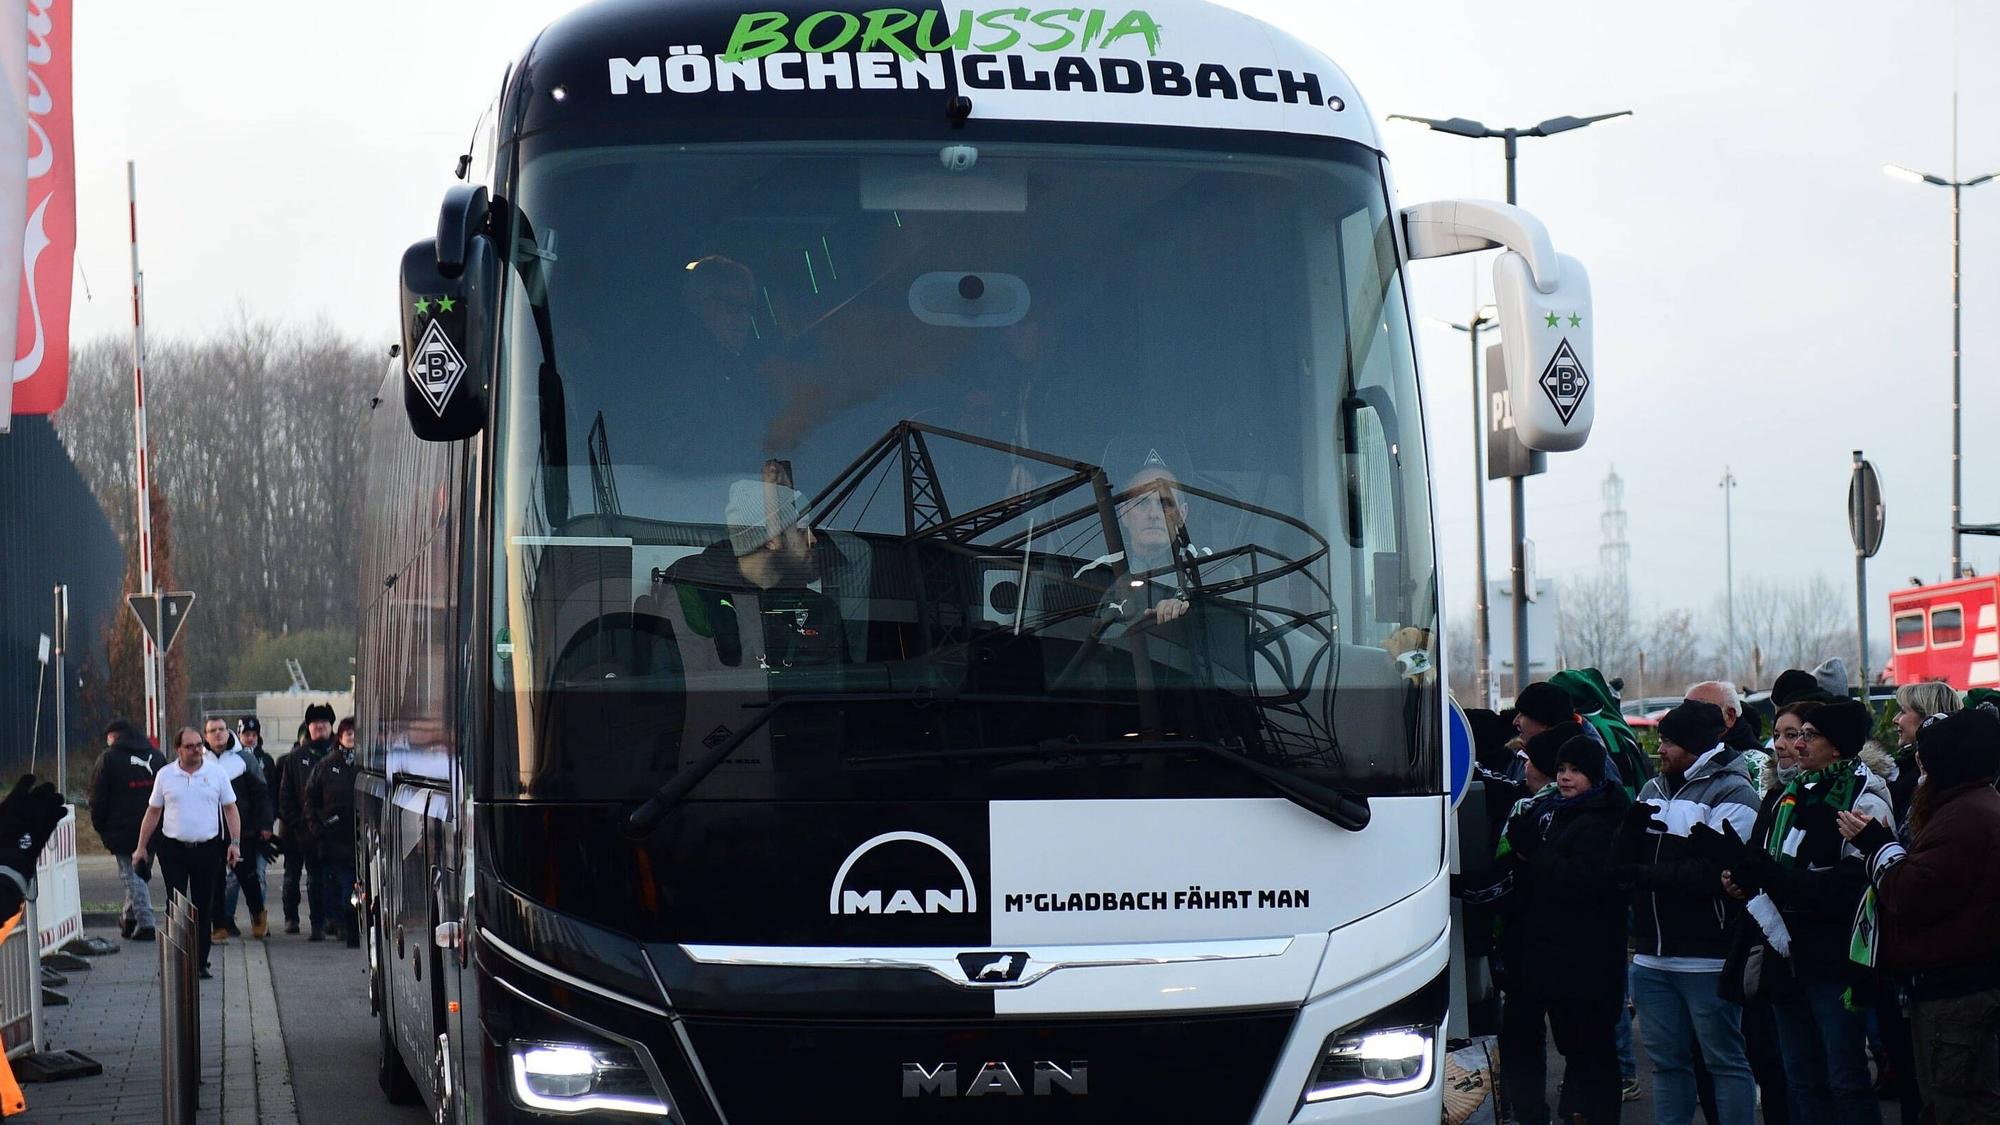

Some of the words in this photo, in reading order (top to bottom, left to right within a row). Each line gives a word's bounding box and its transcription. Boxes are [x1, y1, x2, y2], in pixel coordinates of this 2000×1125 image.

[719, 10, 1163, 63] BORUSSIA
[843, 889, 964, 914] MAN
[1004, 891, 1168, 913] M'GLADBACH
[1173, 885, 1253, 910] FÄHRT
[1257, 889, 1310, 909] MAN
[902, 1060, 1089, 1098] MAN
